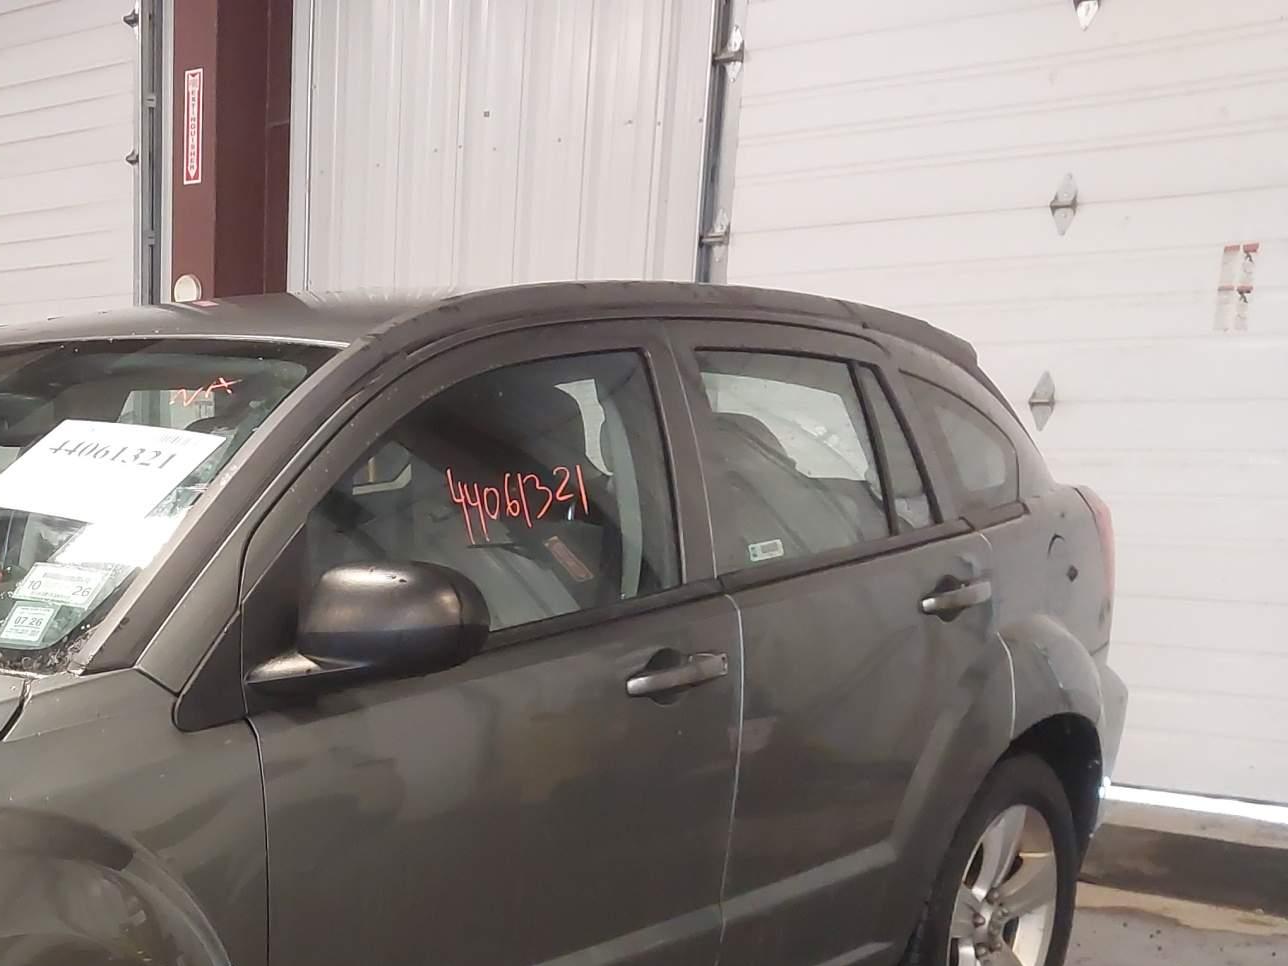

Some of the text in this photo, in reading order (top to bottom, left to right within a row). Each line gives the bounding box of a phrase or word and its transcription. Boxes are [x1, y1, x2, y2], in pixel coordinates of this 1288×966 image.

[49, 440, 177, 469] 44061321
[446, 464, 590, 545] 44061321
[72, 586, 92, 597] 26
